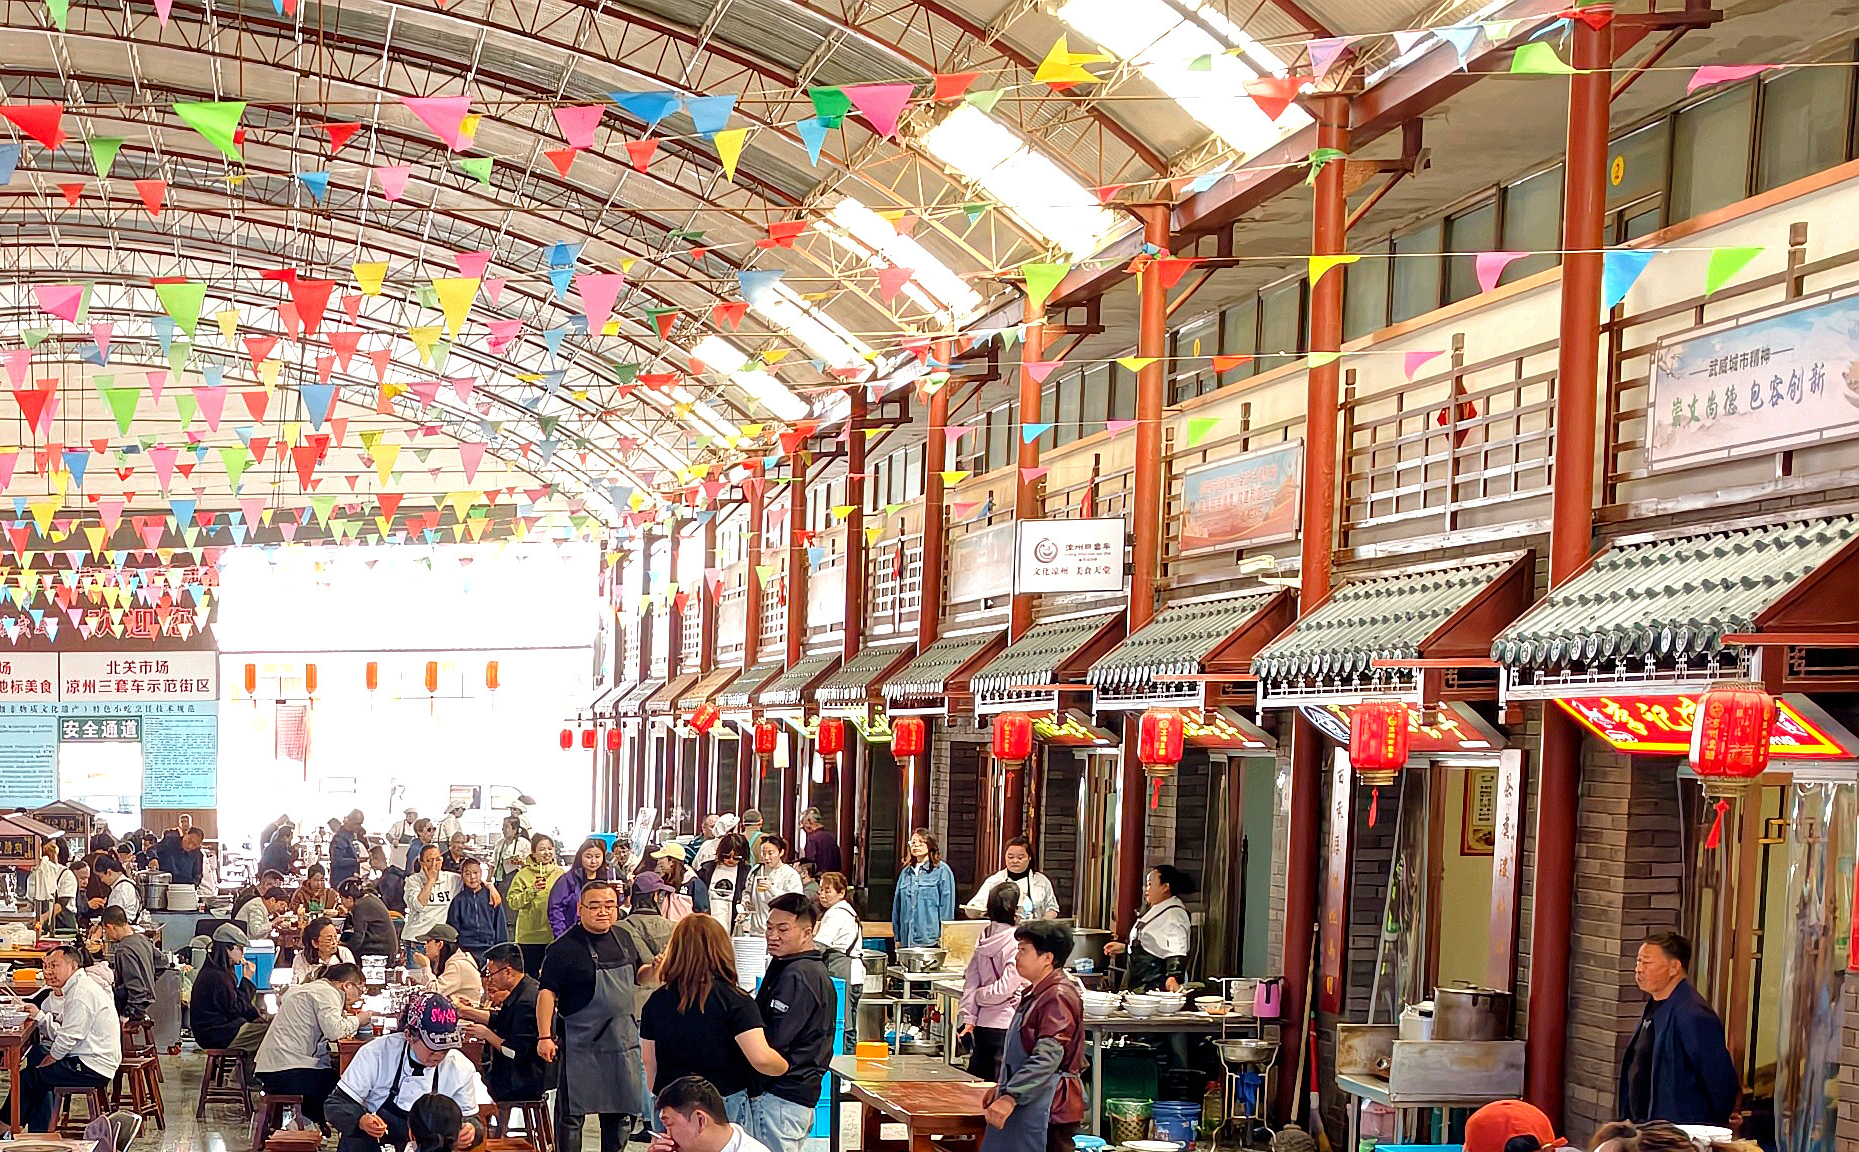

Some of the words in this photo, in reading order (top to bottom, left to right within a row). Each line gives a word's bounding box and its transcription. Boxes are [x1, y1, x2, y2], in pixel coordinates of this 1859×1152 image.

[1672, 384, 1738, 428] 崇文尚德
[1749, 362, 1826, 411] 包容创新
[106, 660, 170, 675] 北关市场
[66, 678, 210, 694] 凉州三套车示范街区
[62, 720, 138, 739] 安全通道
